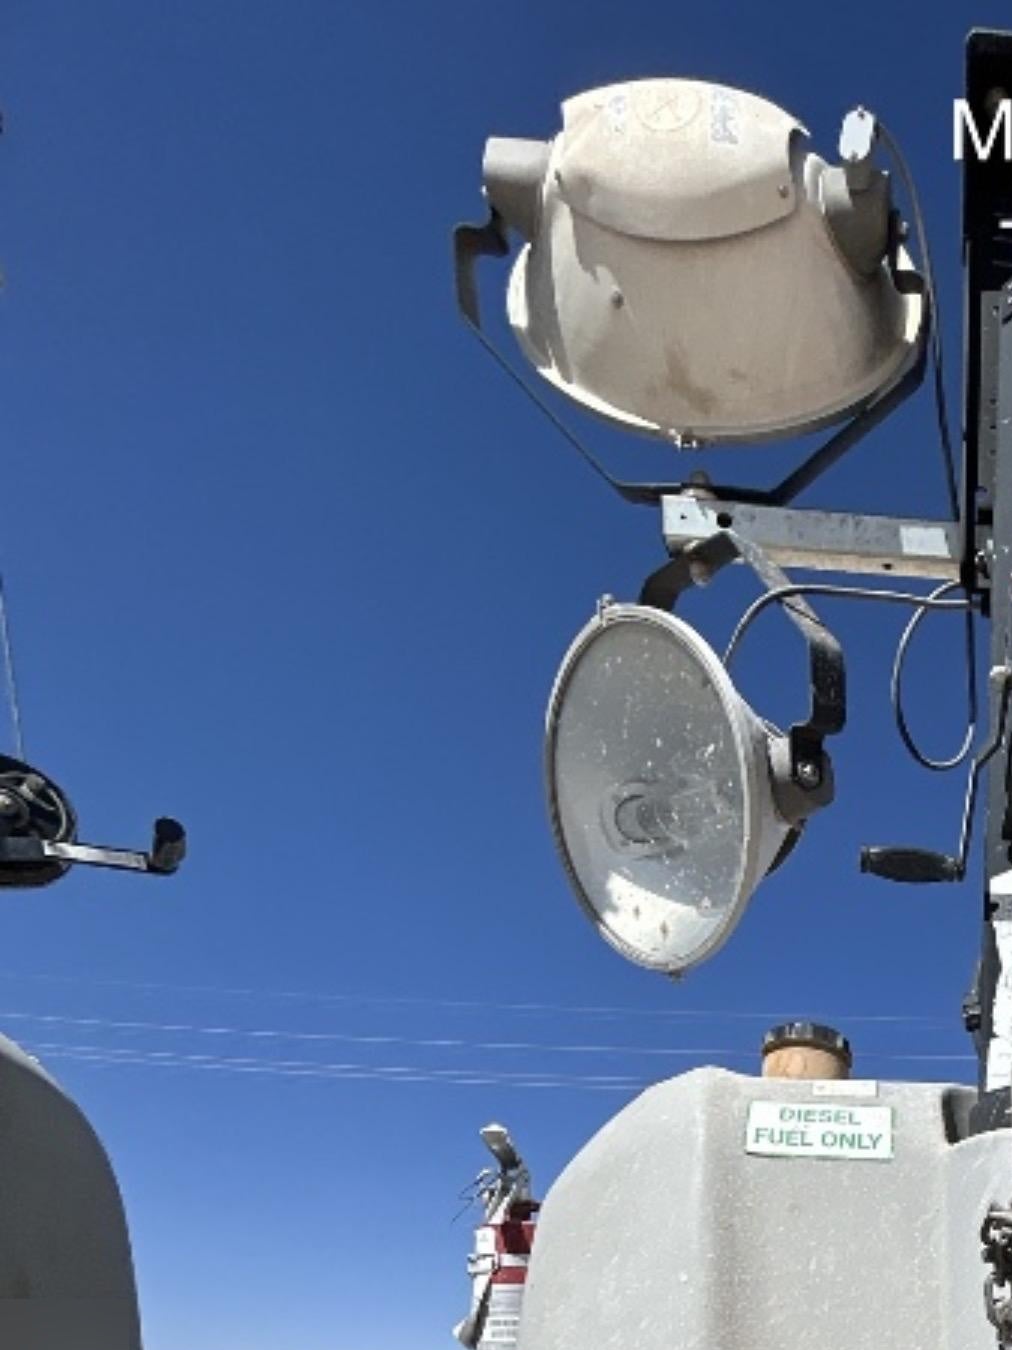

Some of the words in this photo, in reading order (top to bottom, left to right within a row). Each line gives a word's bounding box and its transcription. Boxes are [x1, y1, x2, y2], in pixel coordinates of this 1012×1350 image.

[779, 1106, 862, 1126] DIESEL
[753, 1127, 814, 1147] FUEL
[821, 1130, 883, 1150] ONLY
